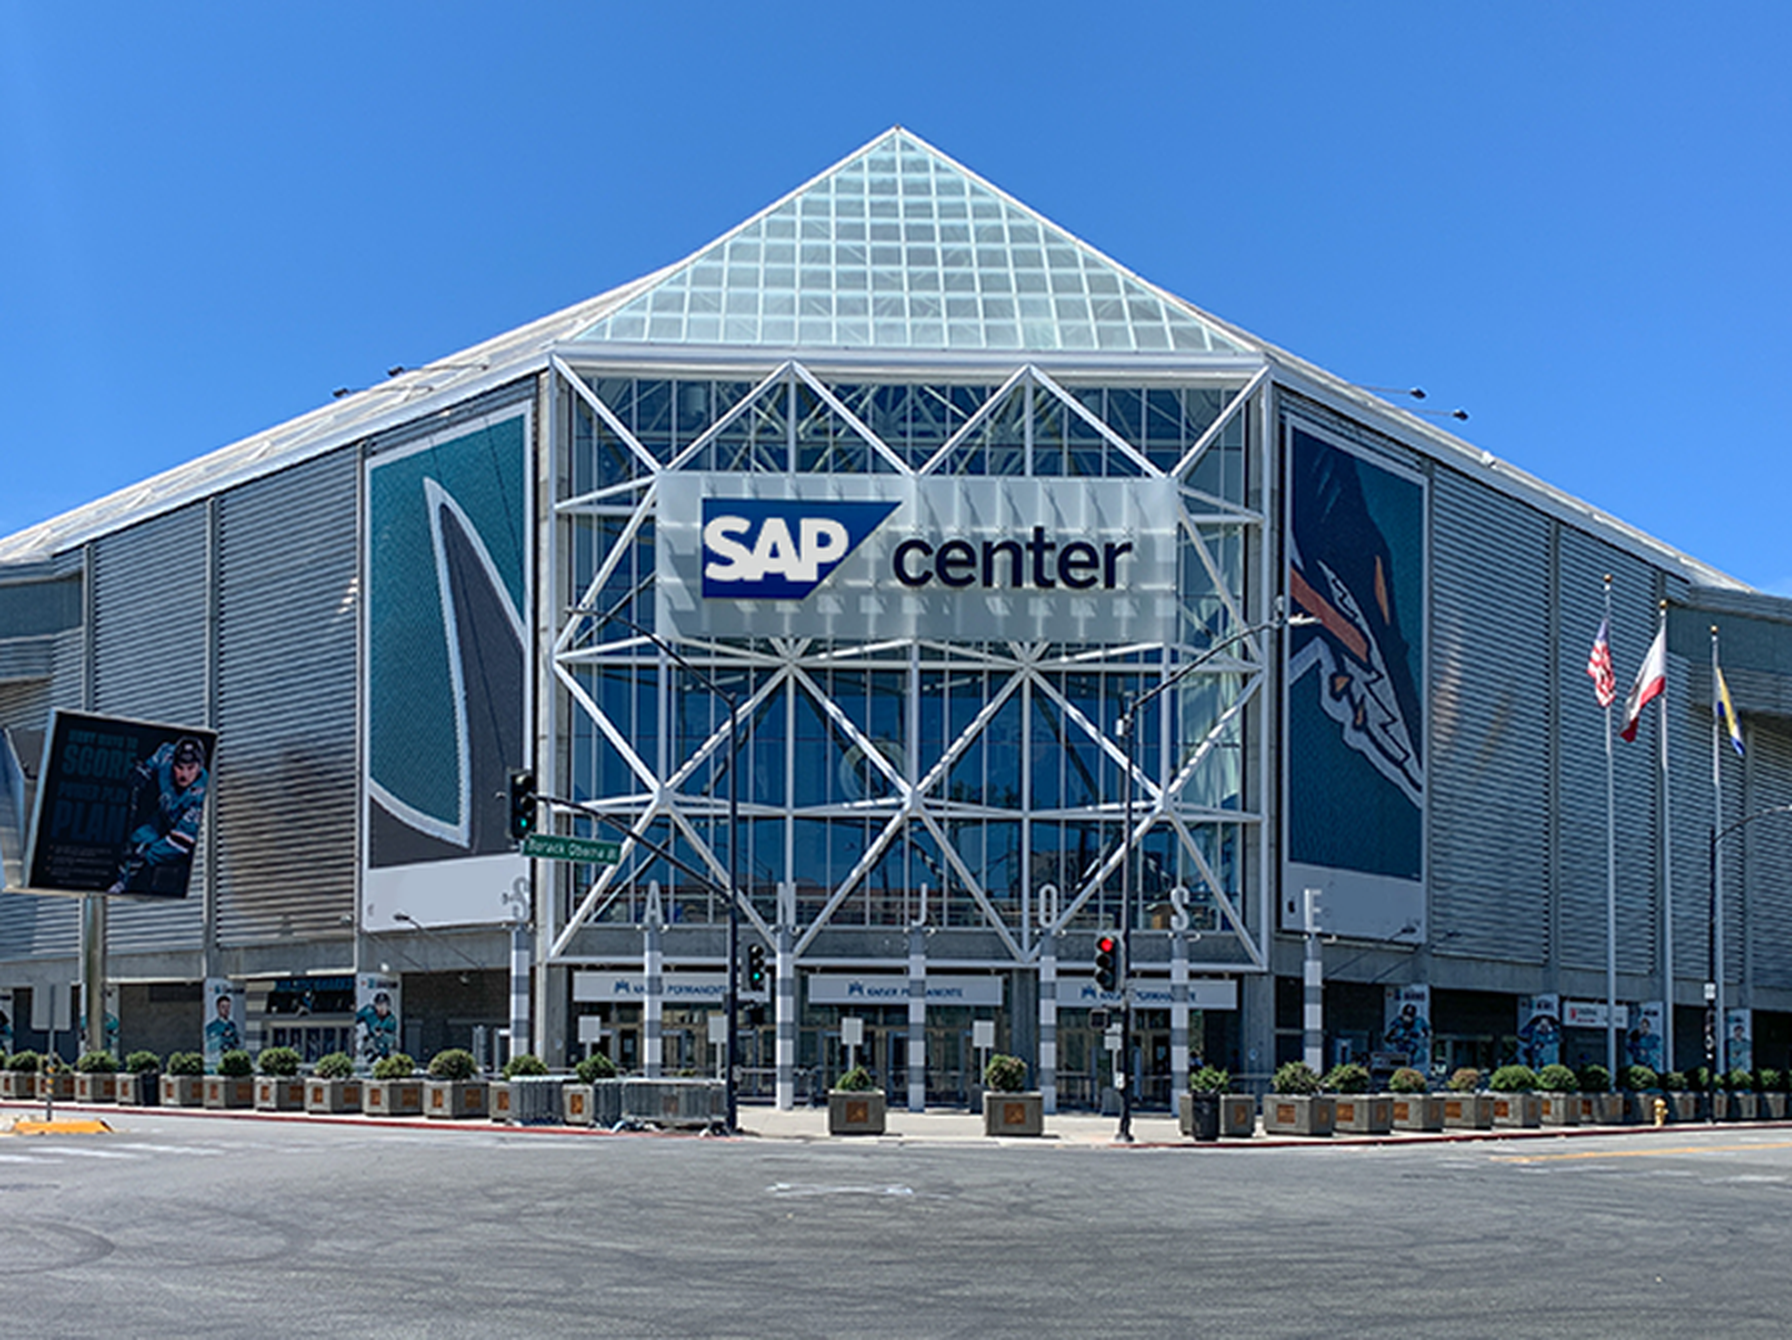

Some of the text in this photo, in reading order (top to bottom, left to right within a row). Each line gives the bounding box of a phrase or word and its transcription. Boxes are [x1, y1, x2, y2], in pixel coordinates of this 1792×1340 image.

[704, 516, 1133, 589] SAP center
[50, 800, 128, 844] PLAN
[568, 842, 605, 859] Obama
